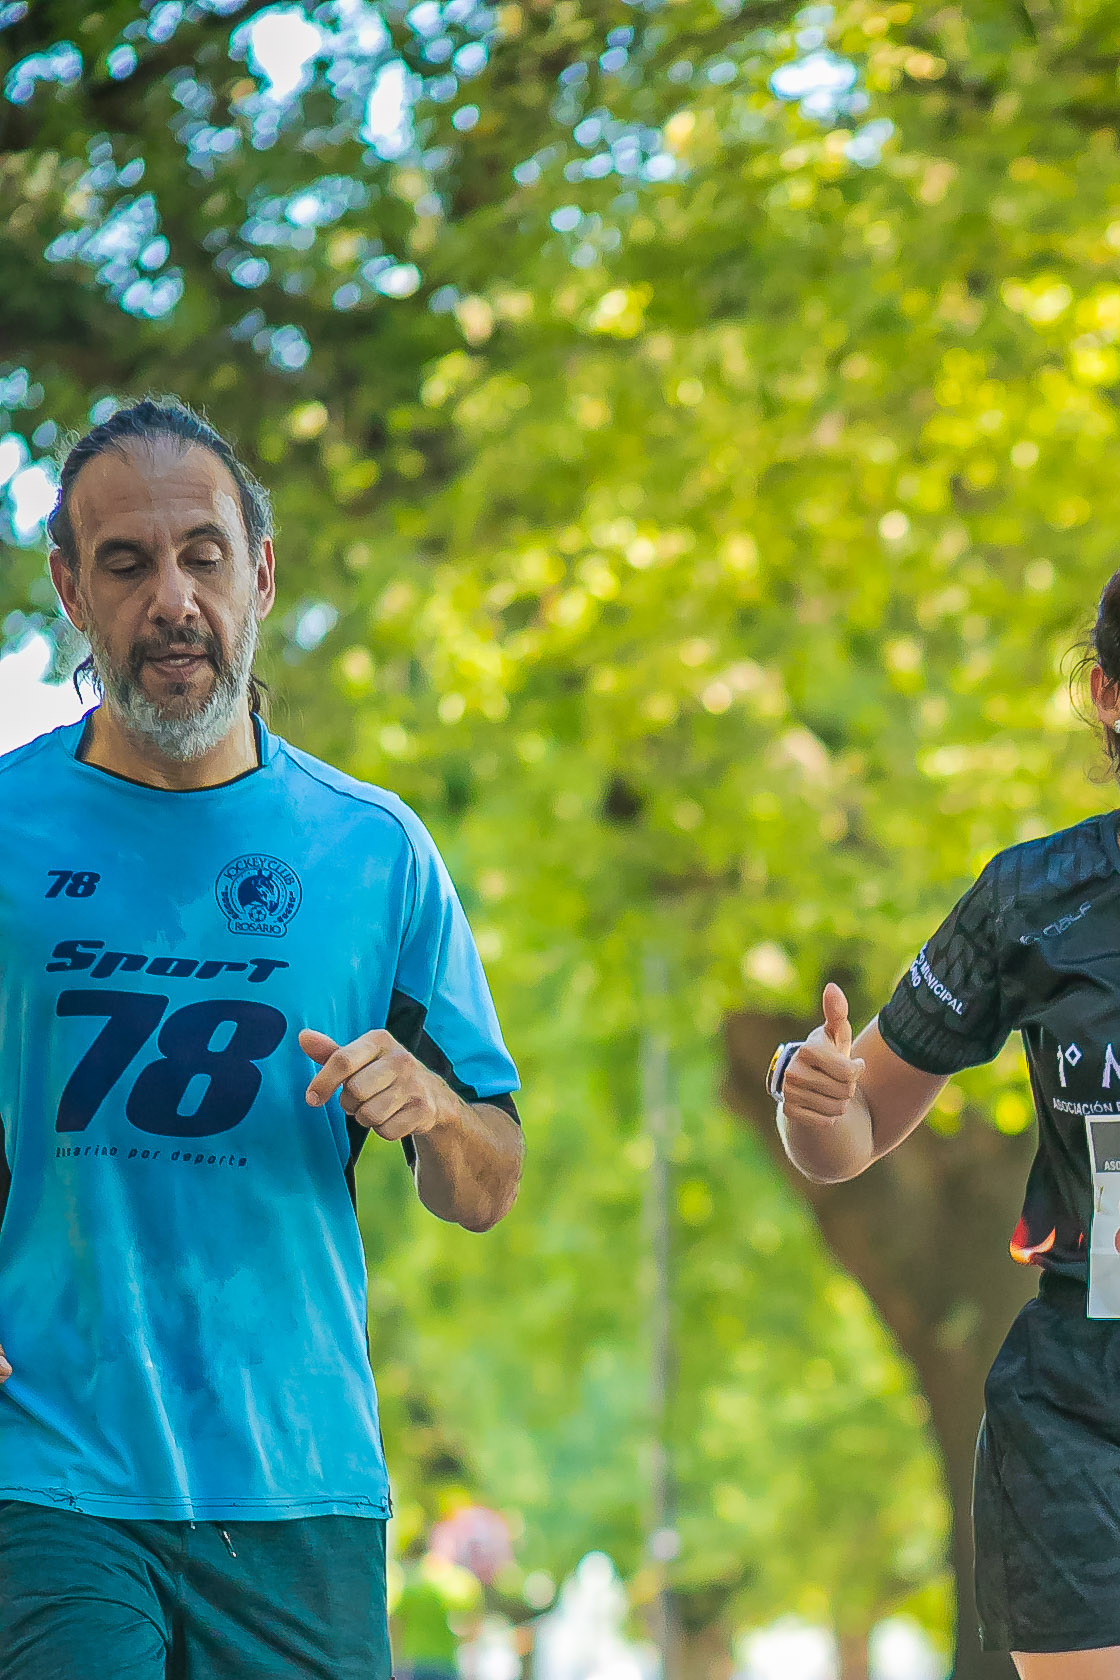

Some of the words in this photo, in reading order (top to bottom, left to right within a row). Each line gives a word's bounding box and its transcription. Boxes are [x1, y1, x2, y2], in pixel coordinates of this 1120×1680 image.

[44, 870, 101, 898] 78
[223, 857, 266, 881] JOCKEY
[267, 860, 295, 886] CLUB
[234, 921, 281, 934] ROSARIO
[45, 940, 290, 983] Sport
[920, 961, 963, 1015] MUNICIPAL
[55, 989, 288, 1138] 78
[1052, 1097, 1113, 1116] ASOCIACIÓN
[127, 1148, 160, 1160] por
[170, 1150, 249, 1167] deporte
